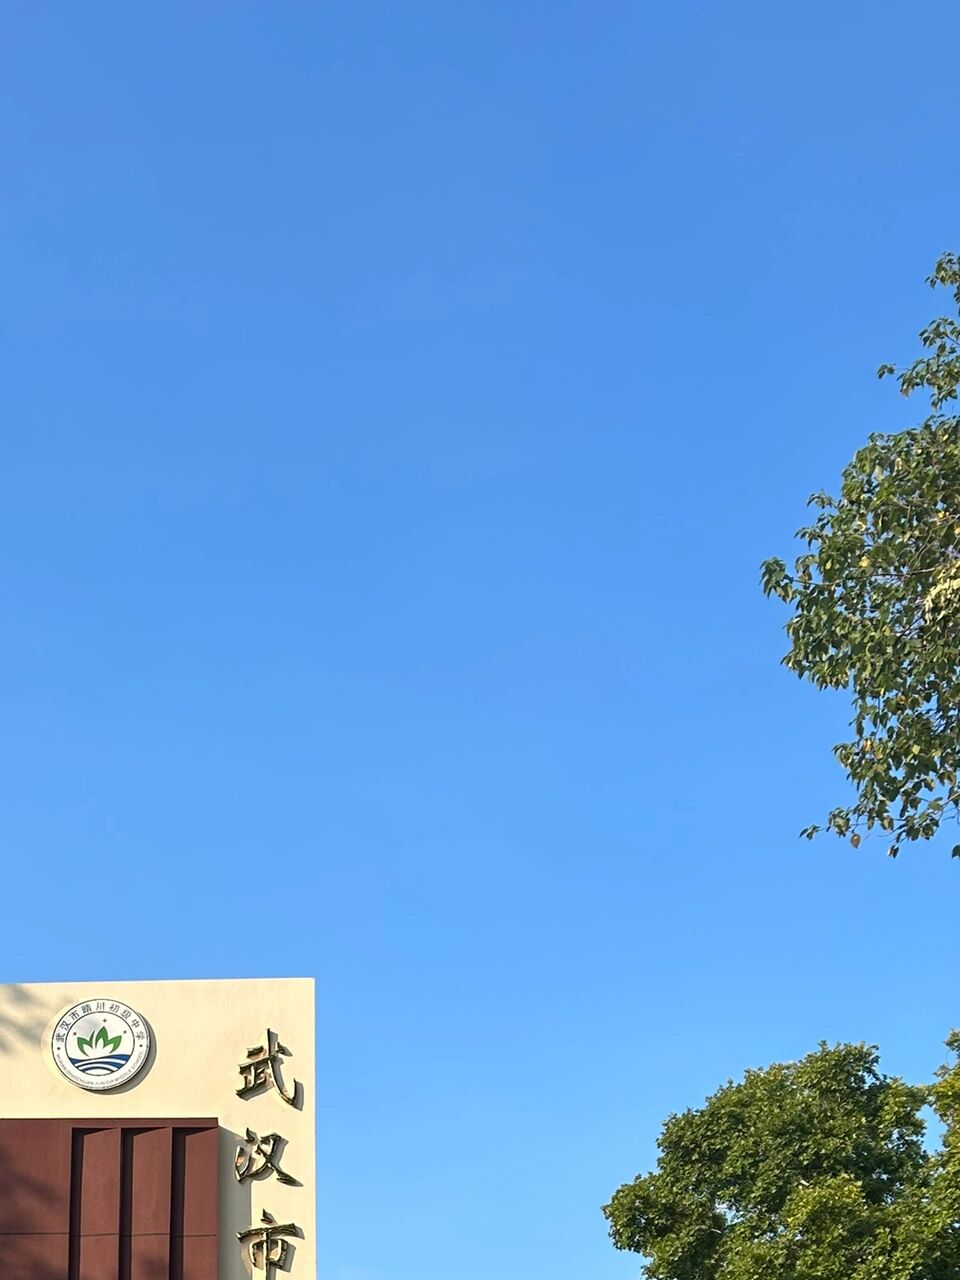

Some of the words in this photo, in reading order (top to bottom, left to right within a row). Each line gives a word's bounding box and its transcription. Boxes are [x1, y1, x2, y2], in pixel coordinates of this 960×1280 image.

[55, 1001, 146, 1043] 武汉市晴川初级中学
